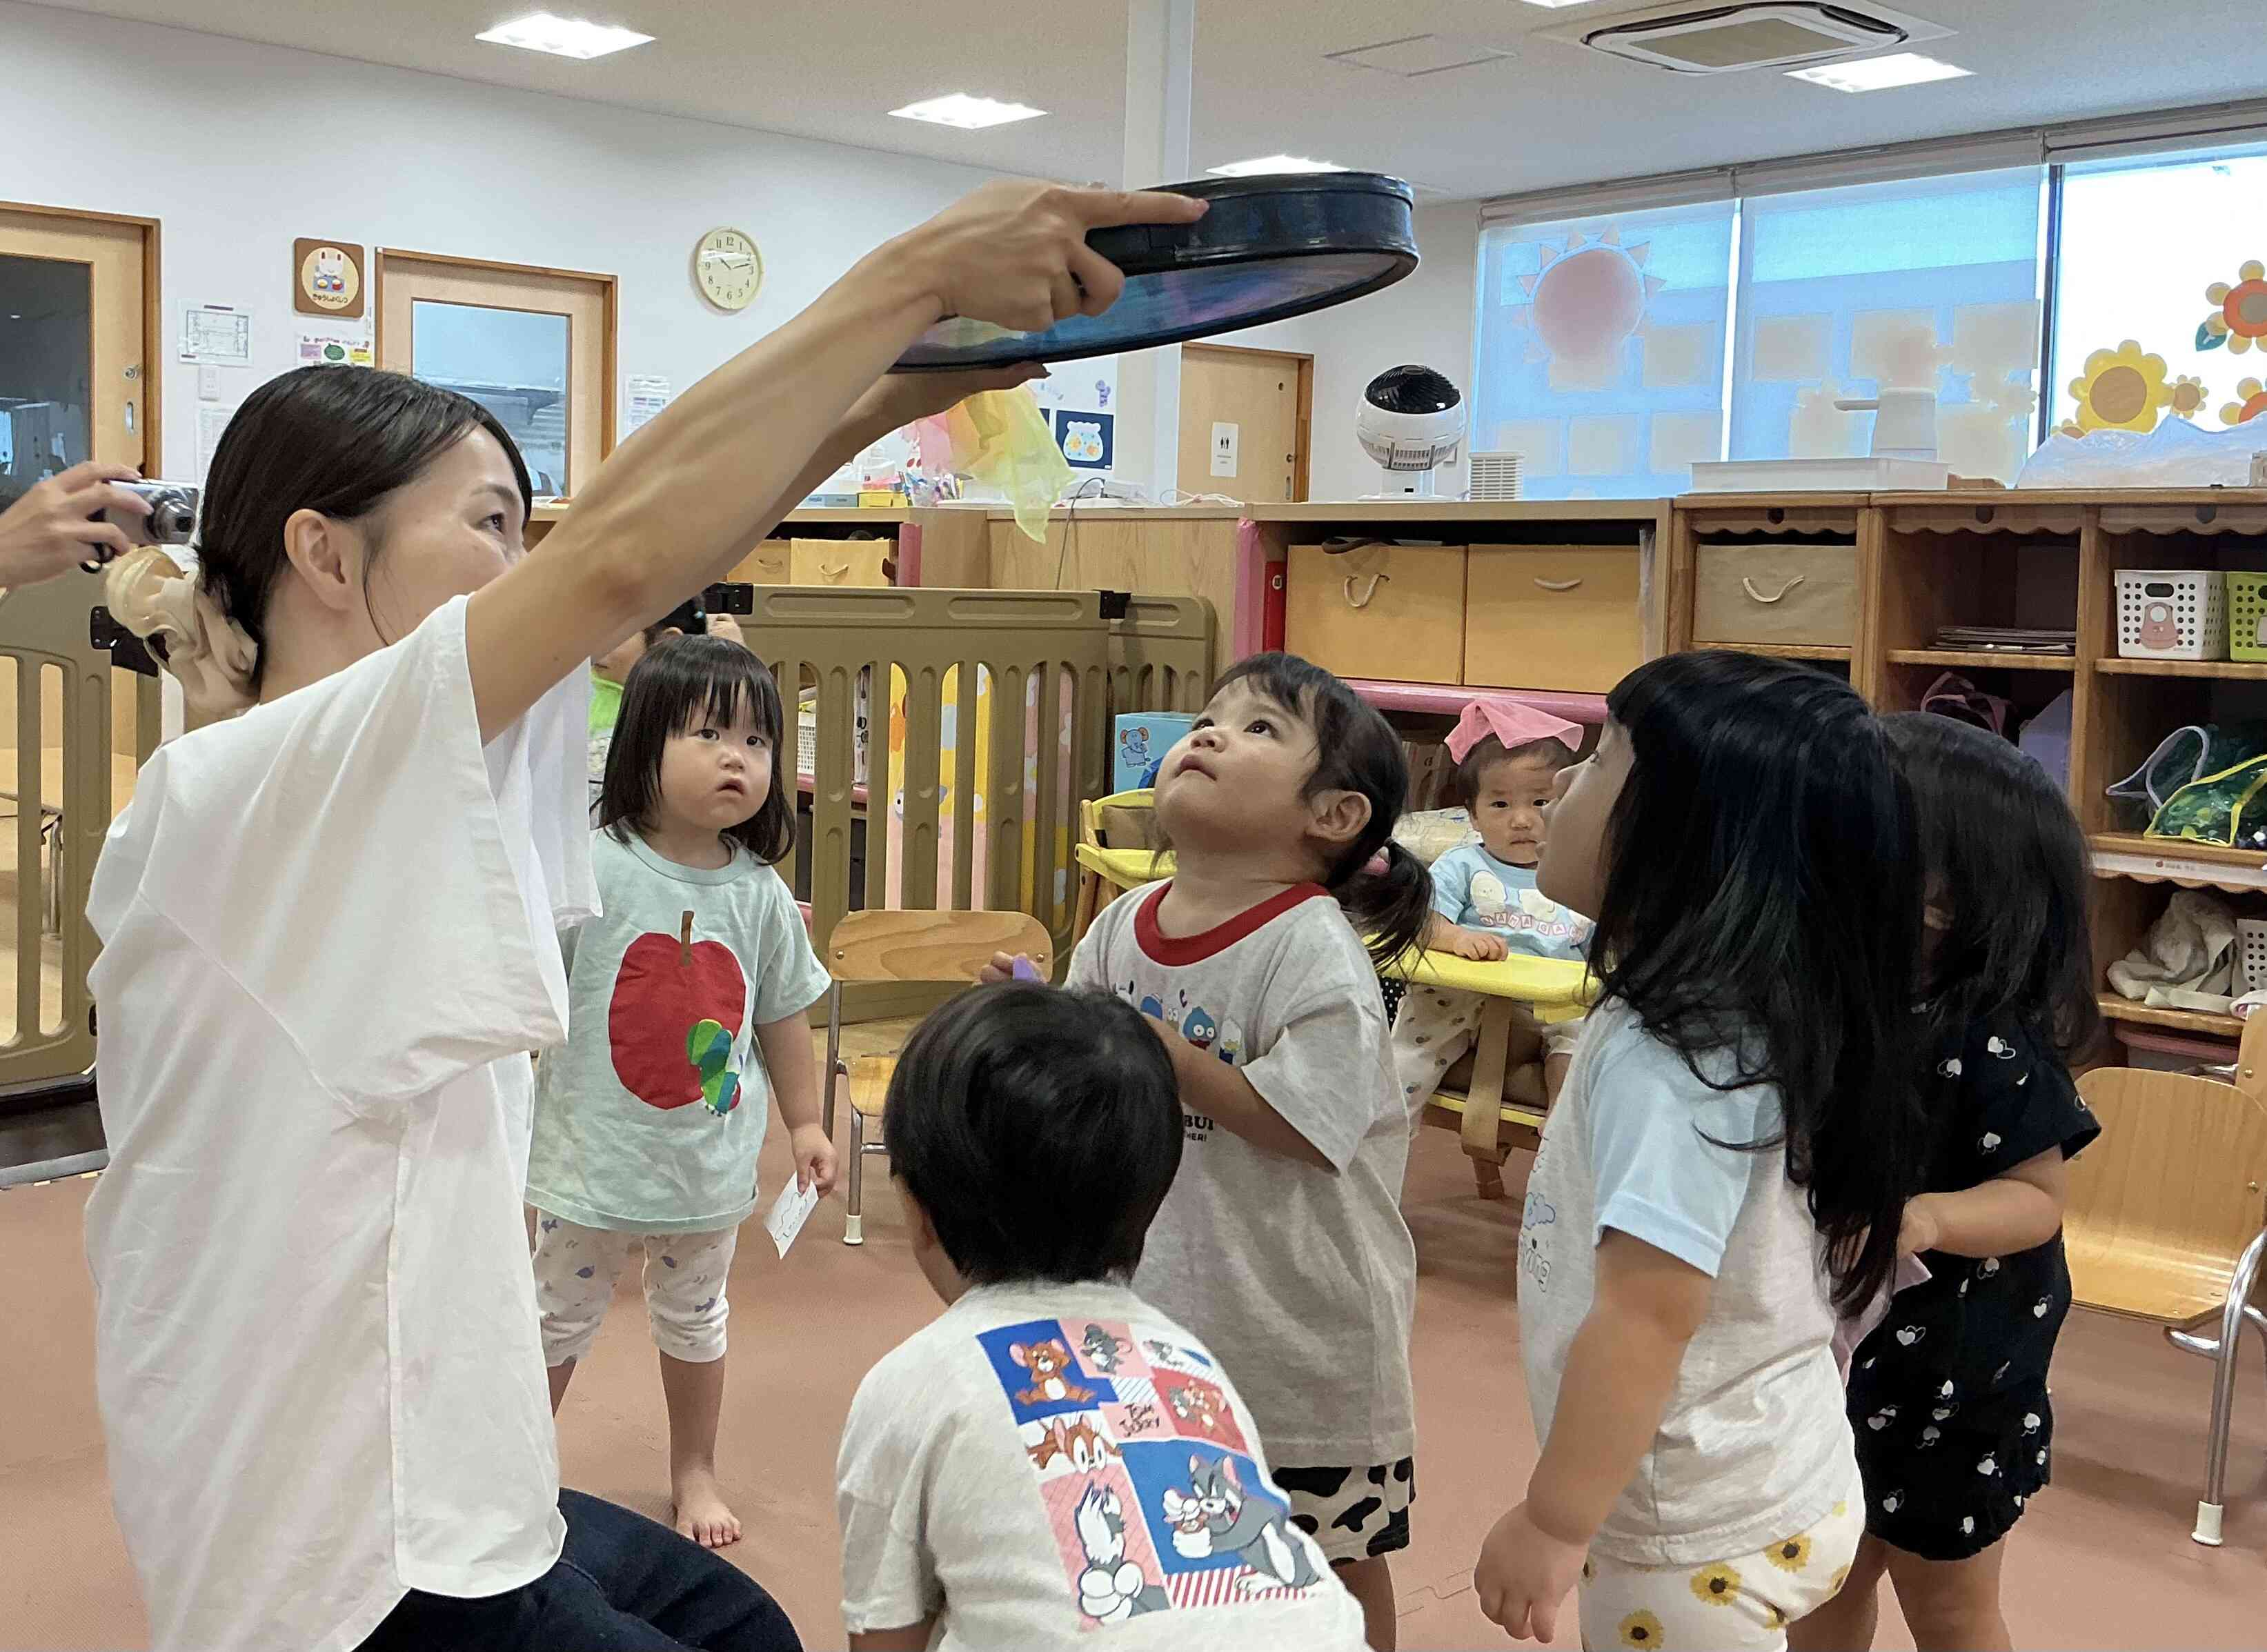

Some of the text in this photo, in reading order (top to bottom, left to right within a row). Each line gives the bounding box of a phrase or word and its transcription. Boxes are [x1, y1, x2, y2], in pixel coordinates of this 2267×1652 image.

[716, 238, 722, 249] 11
[726, 236, 735, 246] 12
[739, 241, 743, 251] 1
[746, 252, 752, 261] 2
[705, 261, 711, 270] 9
[749, 265, 755, 275] 3
[708, 275, 714, 285] 8
[744, 278, 750, 288] 4
[716, 286, 722, 296] 7
[726, 291, 733, 300] 6
[738, 288, 744, 298] 5
